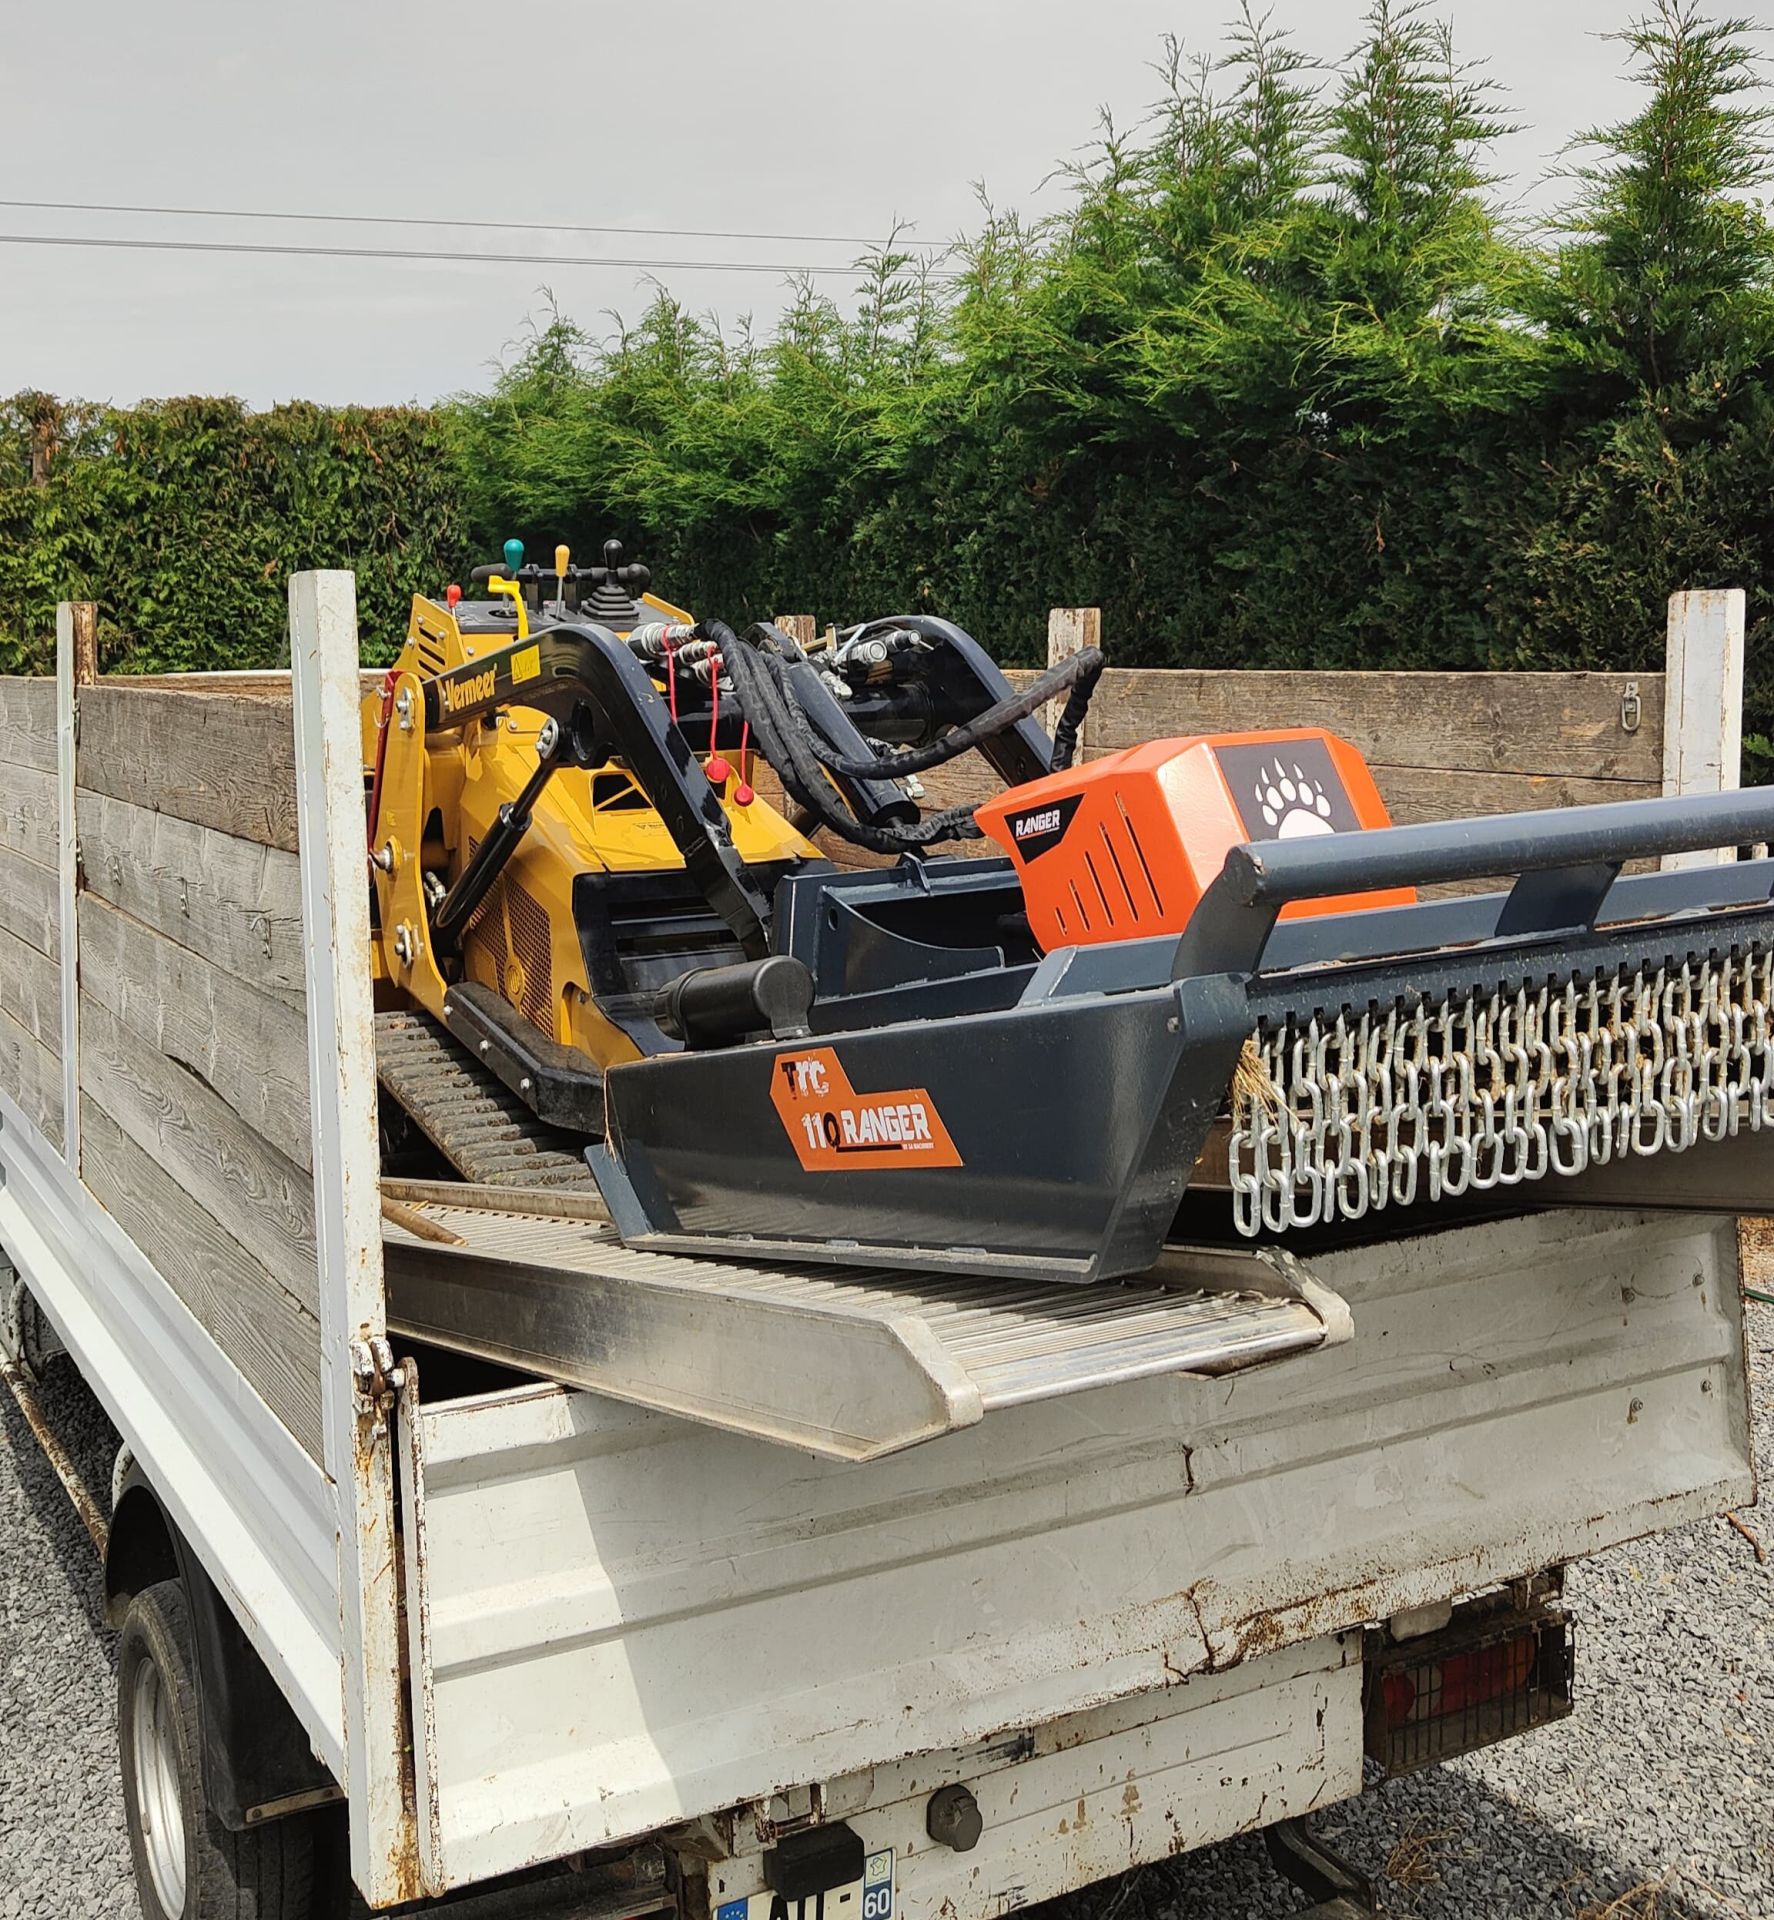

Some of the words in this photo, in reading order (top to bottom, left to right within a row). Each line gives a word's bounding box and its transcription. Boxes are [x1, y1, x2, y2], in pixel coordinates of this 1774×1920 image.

[445, 668, 497, 712] Vermeer
[1015, 809, 1060, 837] RANGER
[801, 1112, 841, 1149] 110
[840, 1104, 932, 1144] RANGER
[864, 1888, 890, 1918] 60
